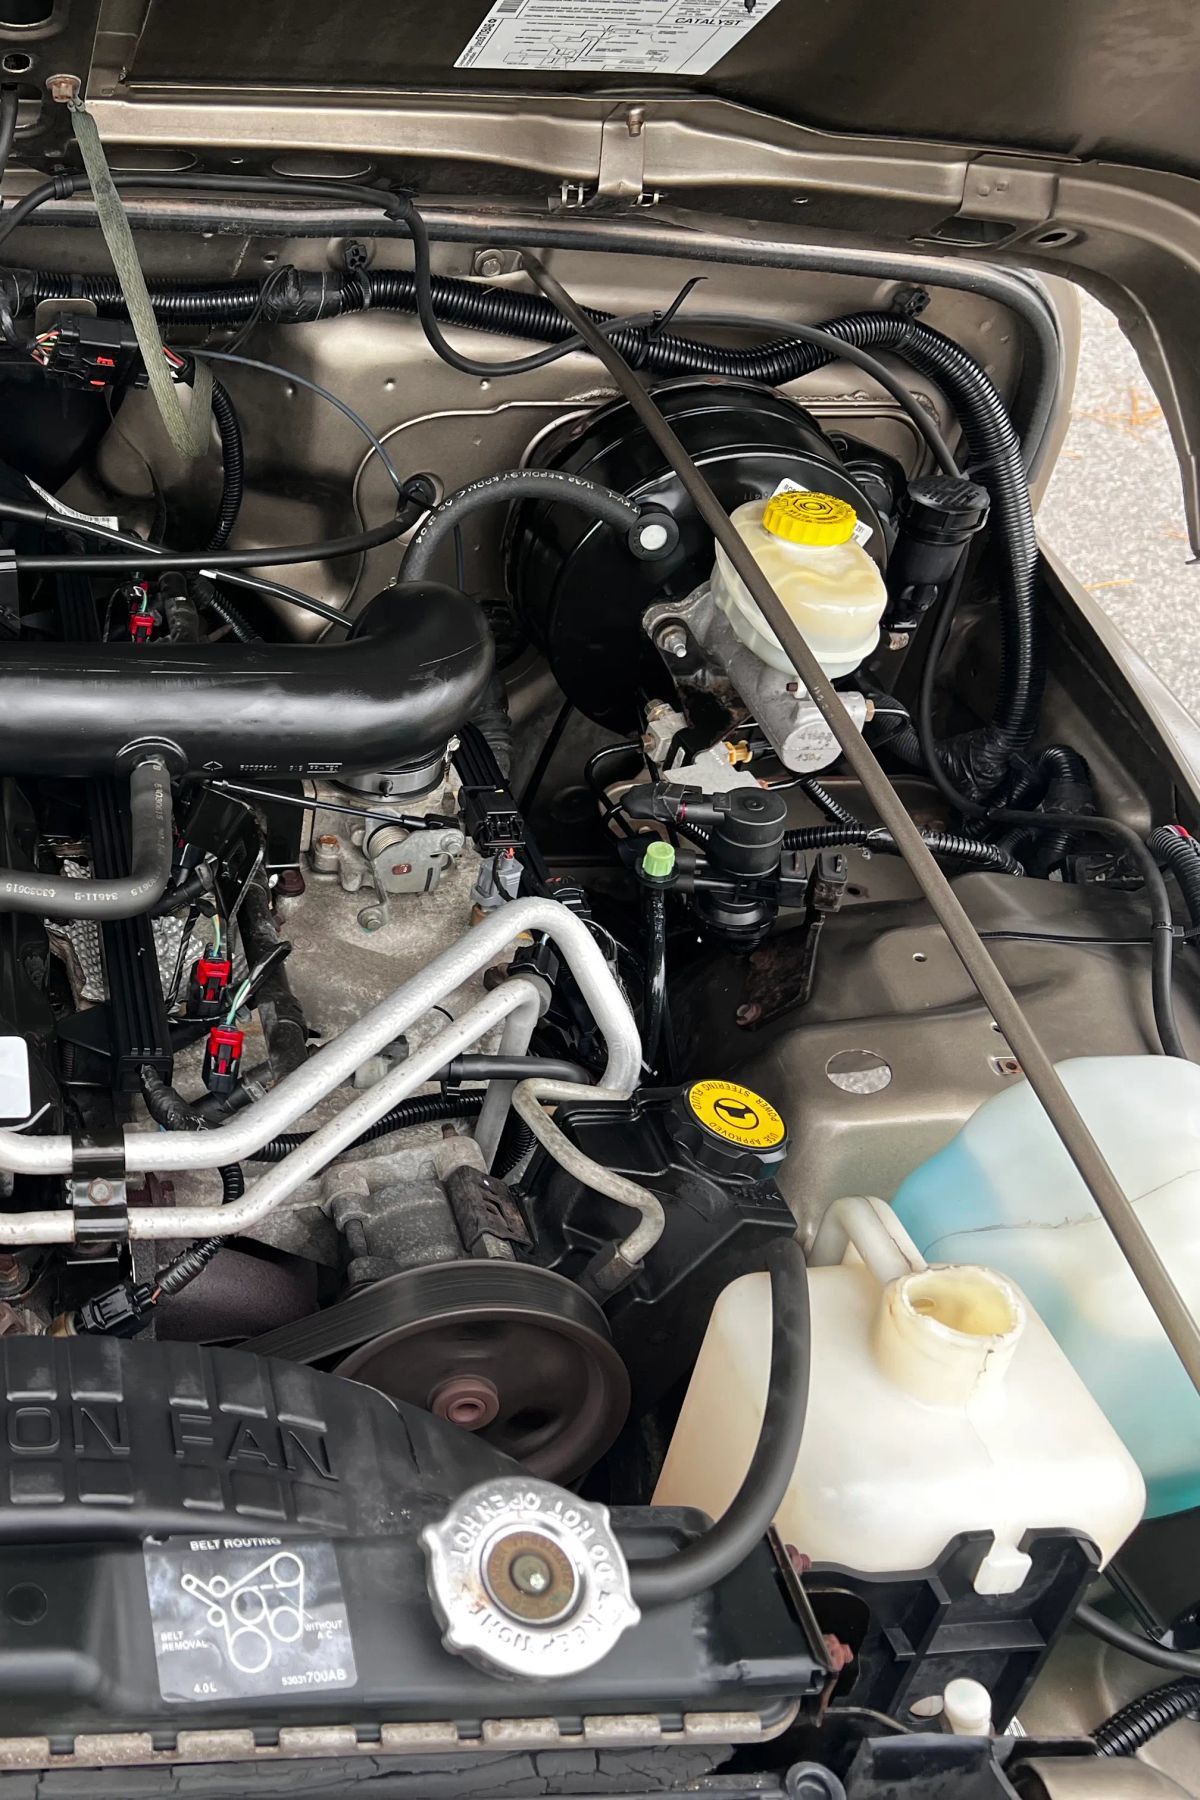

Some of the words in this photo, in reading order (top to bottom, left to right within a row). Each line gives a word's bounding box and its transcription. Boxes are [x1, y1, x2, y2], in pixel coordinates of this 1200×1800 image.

[675, 17, 744, 26] CATALYST
[702, 1082, 751, 1097] STEERING
[691, 1088, 704, 1110] FLUID
[755, 1098, 779, 1122] POWER
[708, 1122, 762, 1145] APPROVED
[763, 1132, 779, 1144] USE
[171, 1413, 341, 1483] FAN
[475, 1492, 541, 1522] OPEN
[547, 1501, 596, 1542] NOT
[190, 1539, 221, 1551] BELT
[224, 1537, 282, 1549] ROUTING
[450, 1514, 484, 1563] HOT
[304, 1620, 343, 1631] WITHOUT
[161, 1631, 184, 1641] BELT
[162, 1640, 208, 1651] REMOVAL
